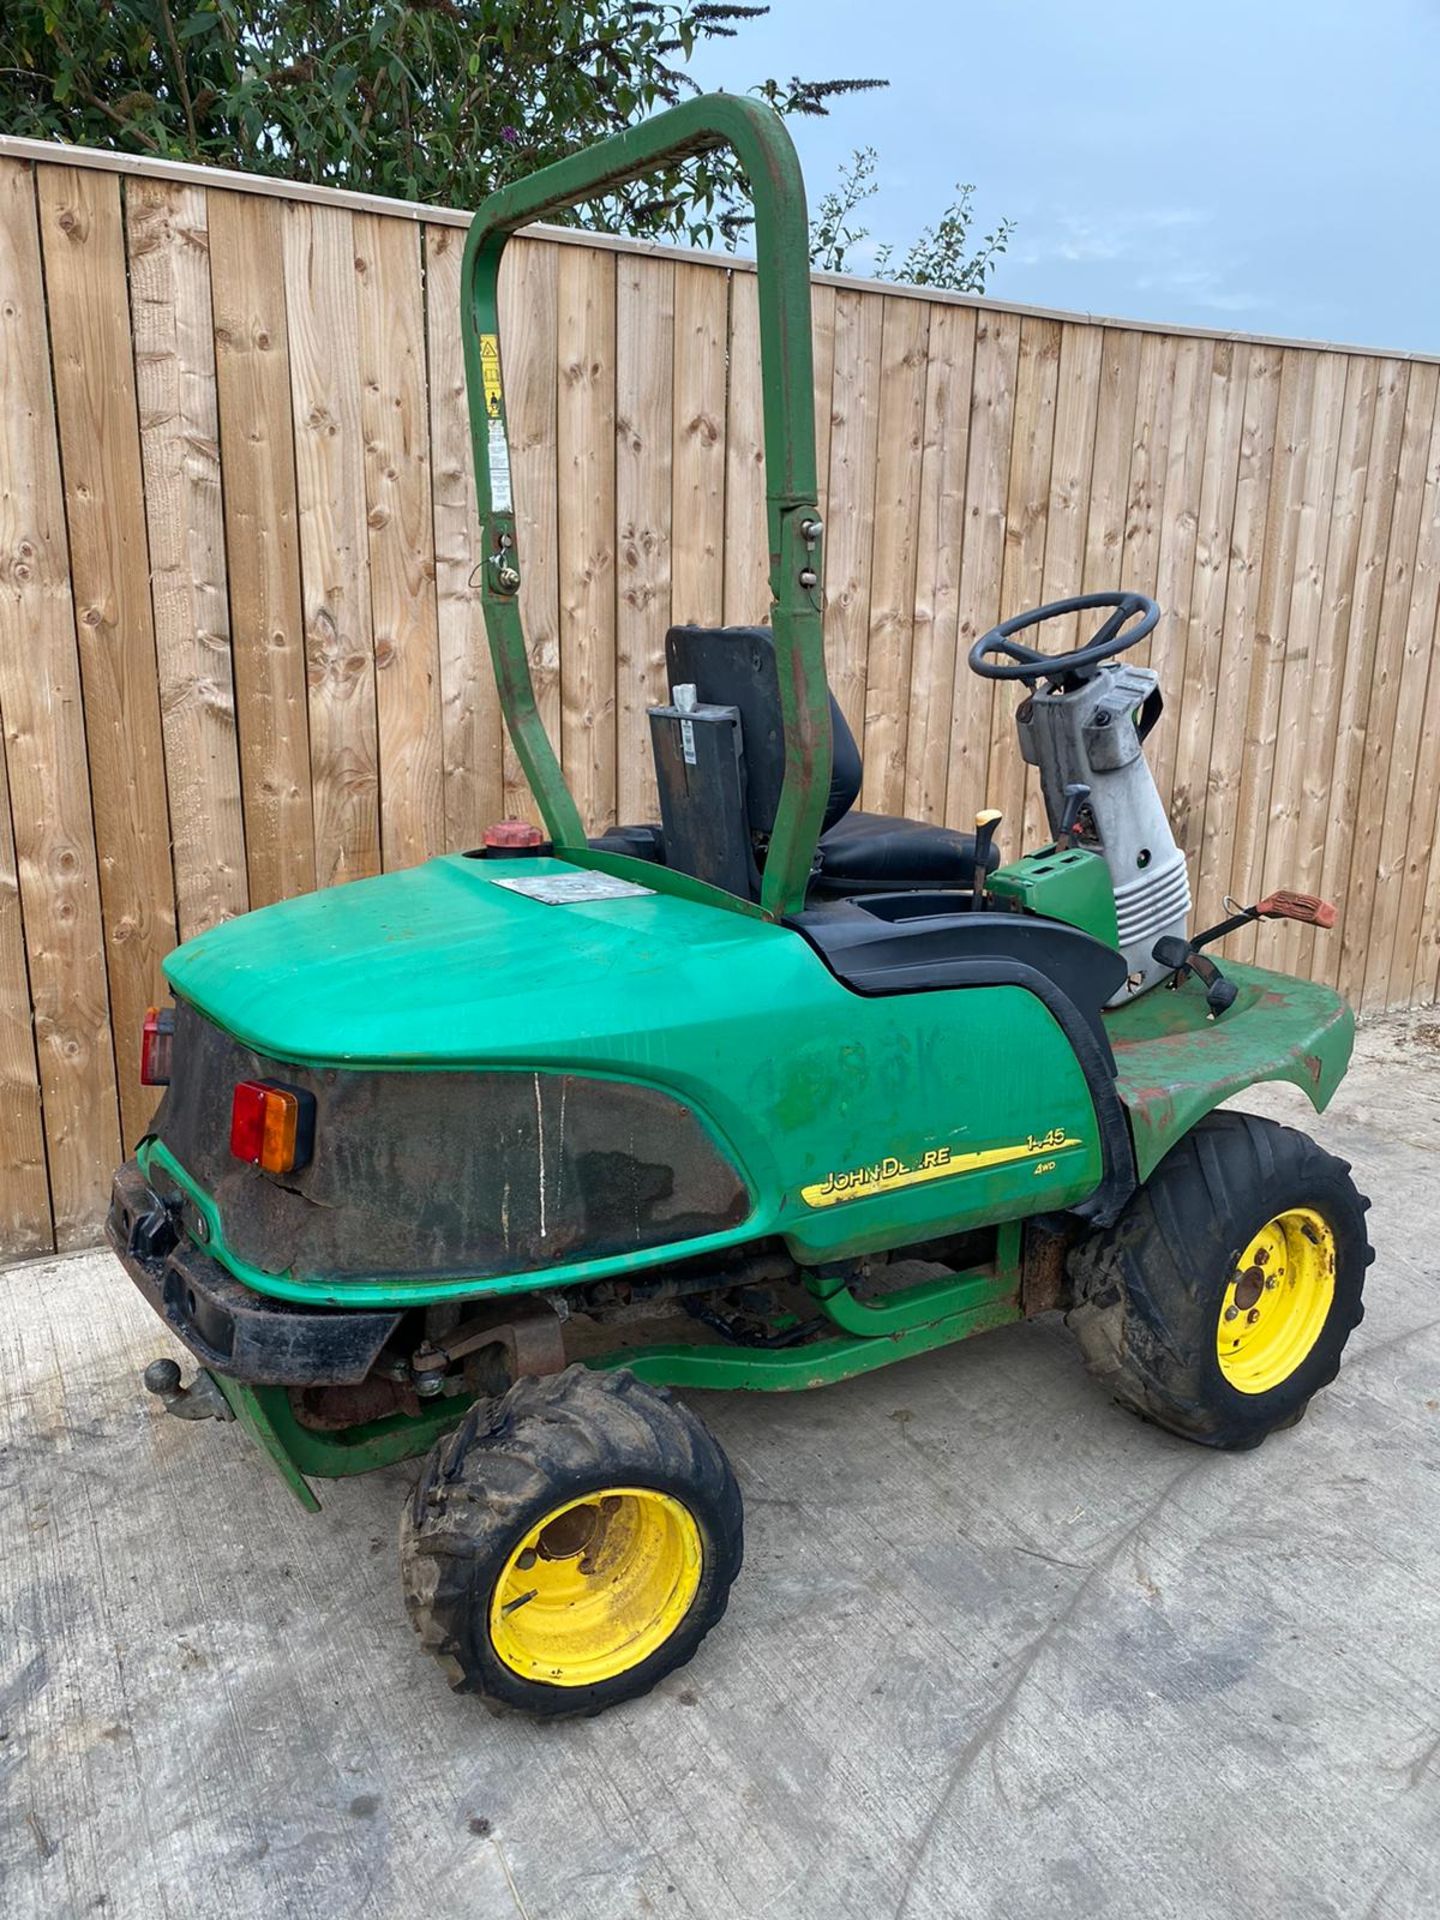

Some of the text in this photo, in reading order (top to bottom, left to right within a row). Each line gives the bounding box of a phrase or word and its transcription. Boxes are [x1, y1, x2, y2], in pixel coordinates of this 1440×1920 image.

[1027, 1127, 1065, 1151] 145
[820, 1164, 881, 1195] JOHN
[1034, 1161, 1056, 1176] 4WD
